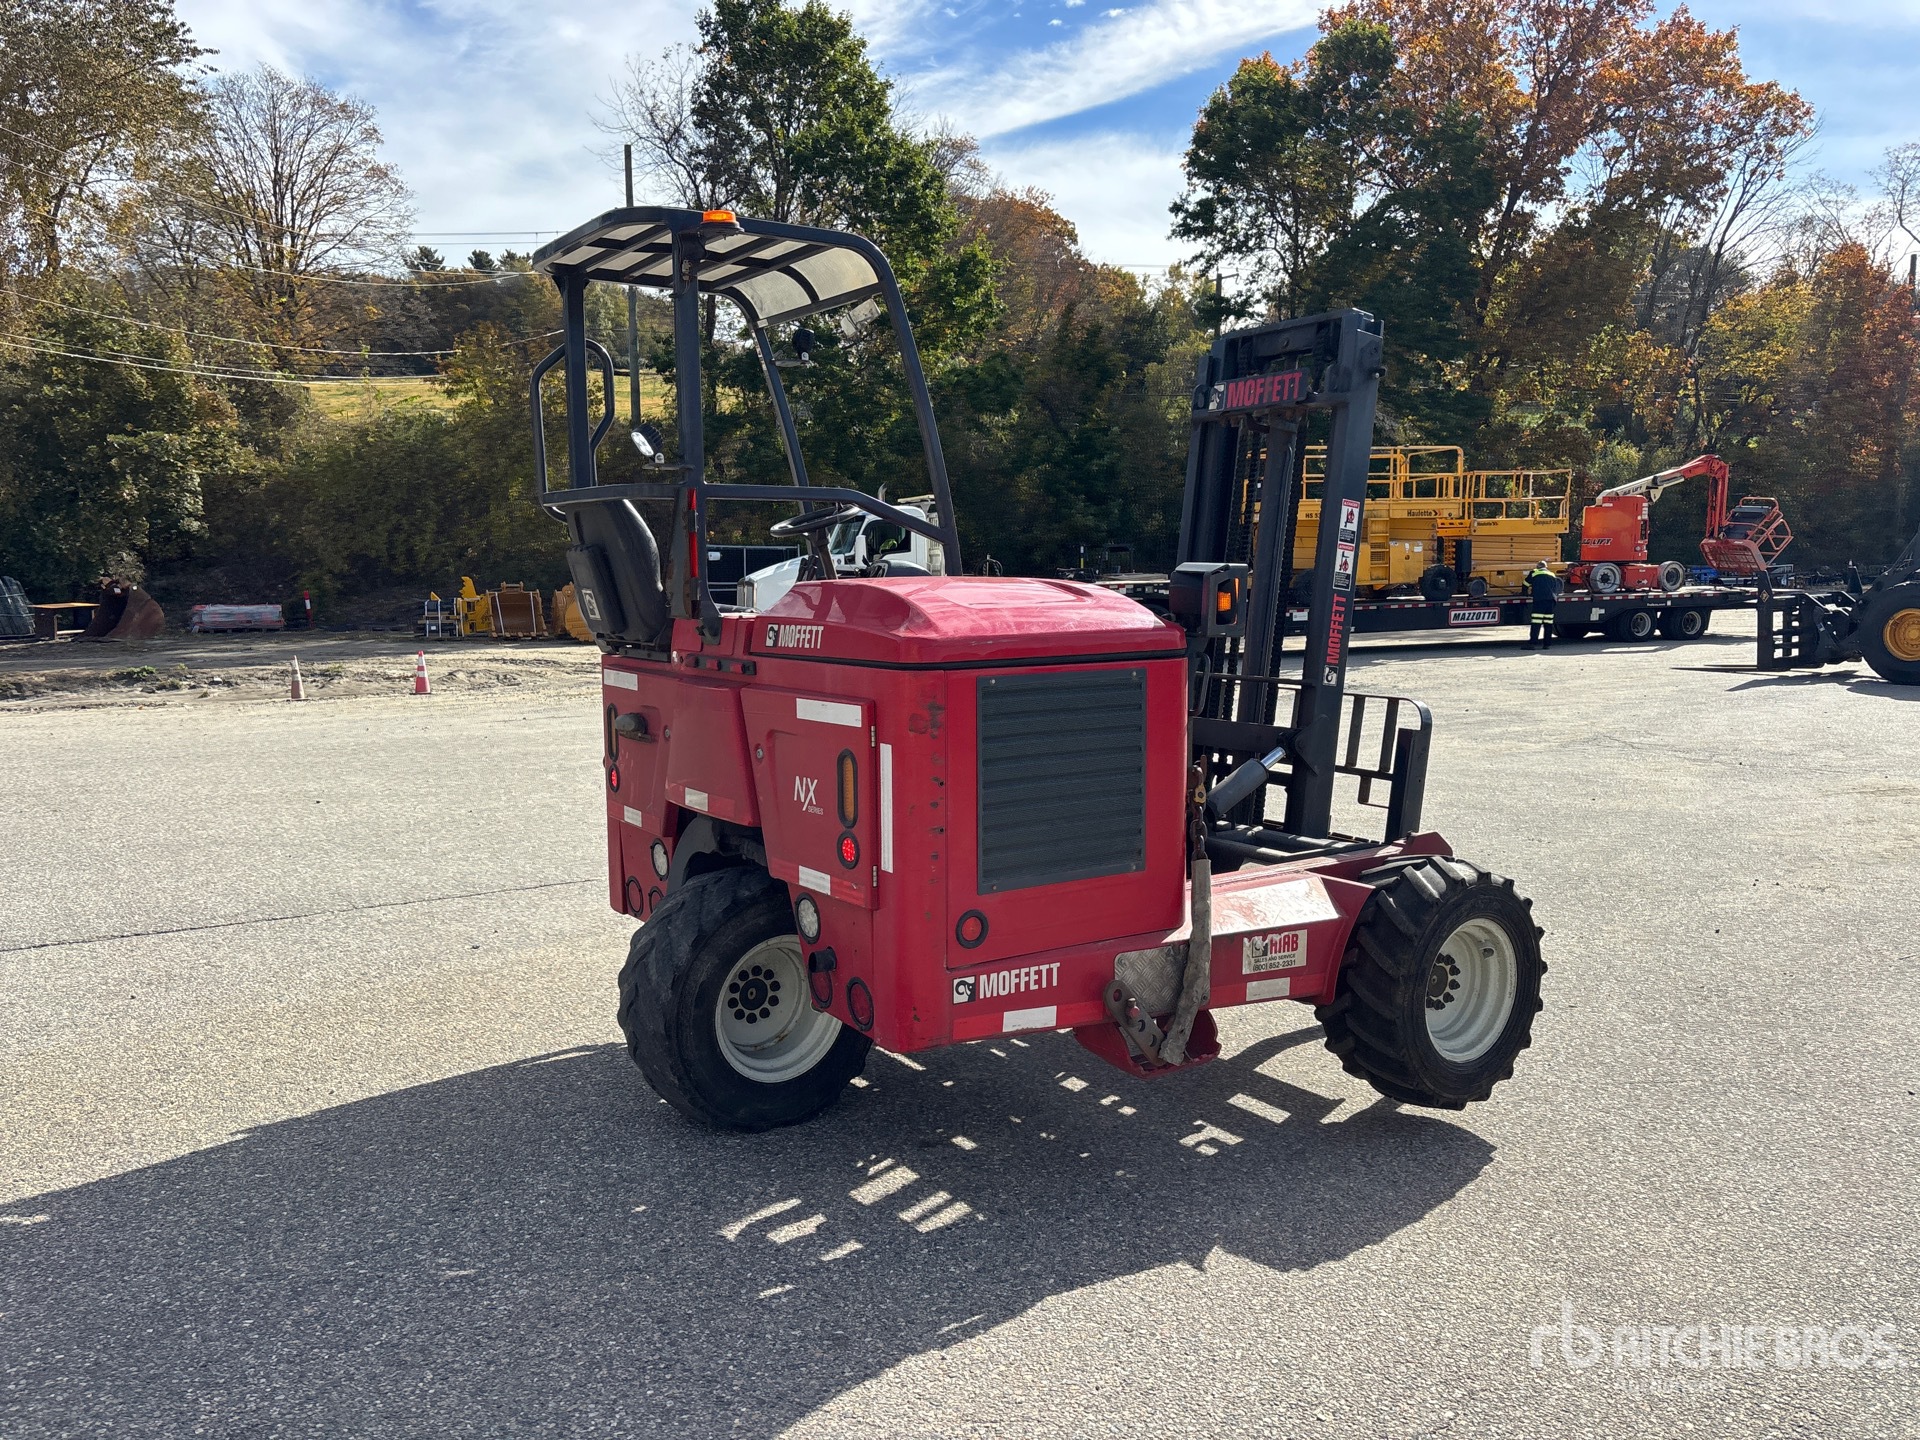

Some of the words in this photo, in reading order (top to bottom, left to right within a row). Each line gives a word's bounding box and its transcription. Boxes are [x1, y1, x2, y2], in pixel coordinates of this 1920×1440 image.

[1226, 372, 1302, 408] MOFFETT
[1407, 509, 1432, 517] Haulotte
[1326, 593, 1347, 664] MOFFETT
[1452, 611, 1496, 622] MAZZOTTA
[778, 624, 824, 649] MOFFETT
[793, 775, 818, 811] NX
[807, 805, 824, 816] SERIES
[1253, 956, 1268, 964] SALES
[1278, 953, 1296, 961] SERVICE
[979, 962, 1060, 999] MOFFETT
